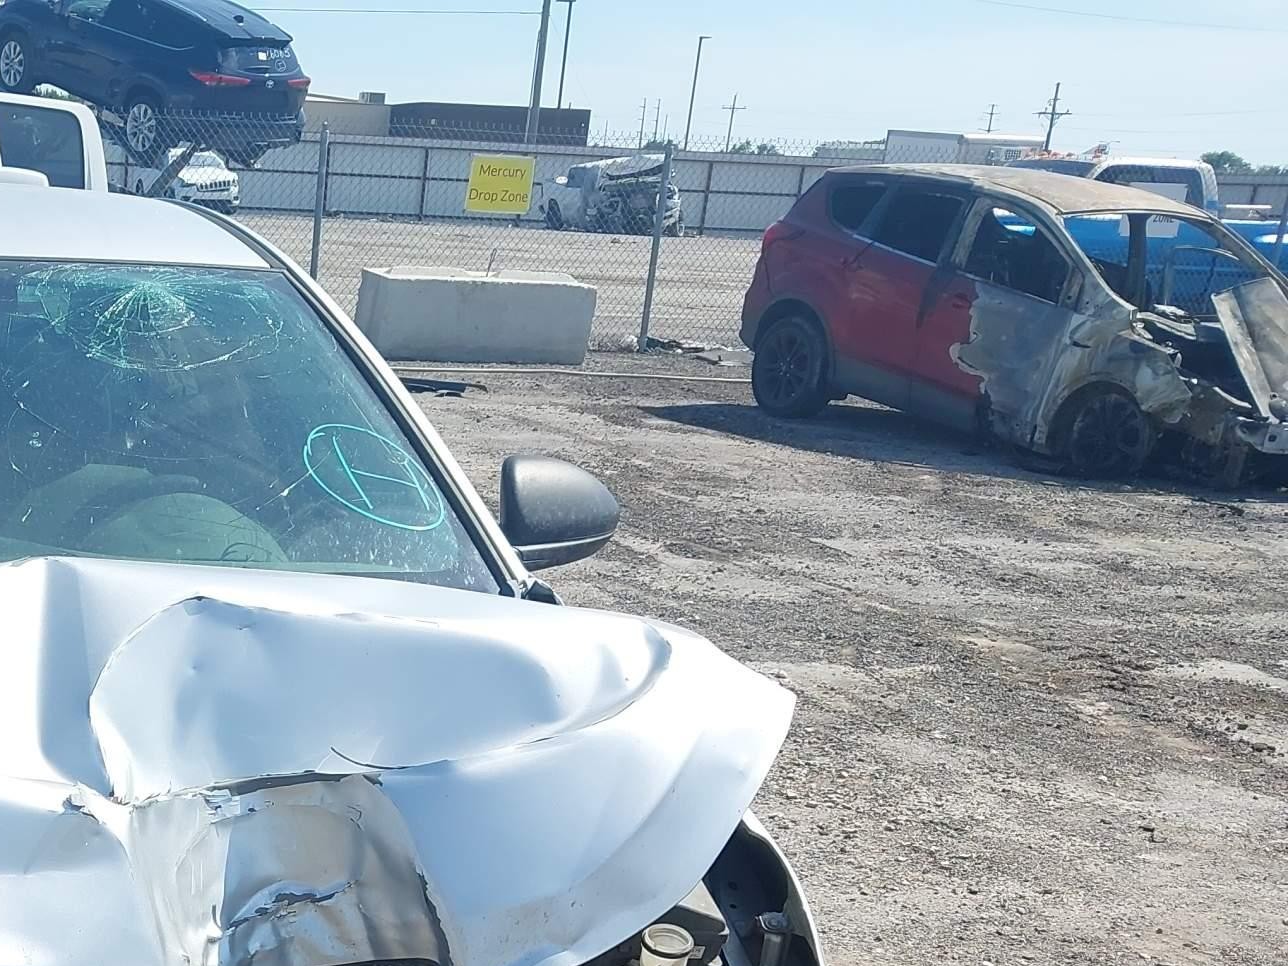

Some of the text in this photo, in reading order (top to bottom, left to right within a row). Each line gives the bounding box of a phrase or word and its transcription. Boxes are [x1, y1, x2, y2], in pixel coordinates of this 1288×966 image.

[479, 164, 527, 179] Mercury
[469, 188, 528, 203] Drop Zone
